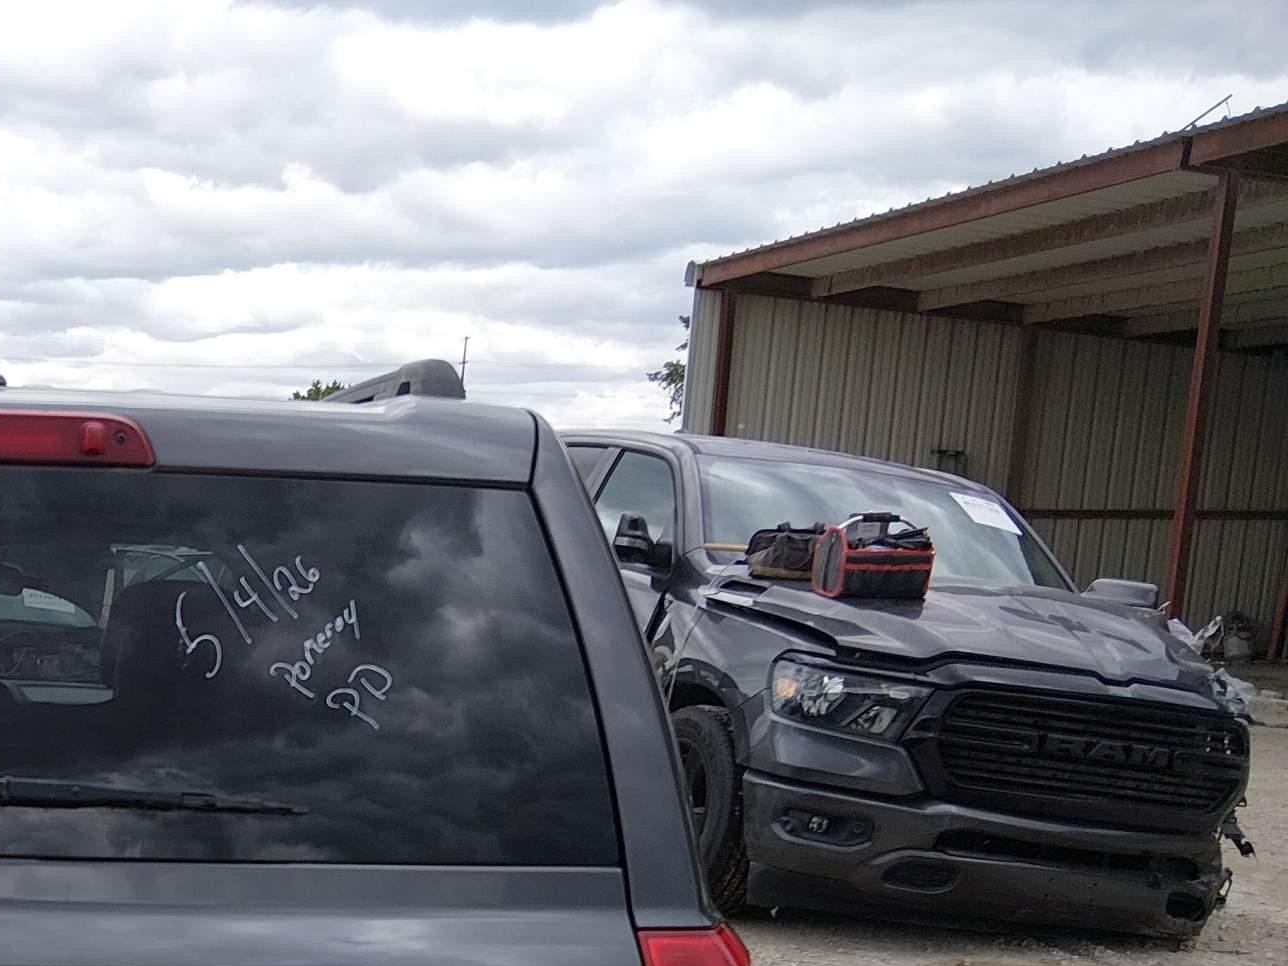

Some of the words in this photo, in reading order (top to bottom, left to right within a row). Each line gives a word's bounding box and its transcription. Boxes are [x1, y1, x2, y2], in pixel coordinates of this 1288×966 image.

[175, 544, 320, 679] 5/4/26
[326, 664, 393, 730] PD
[1046, 734, 1169, 768] RAM
